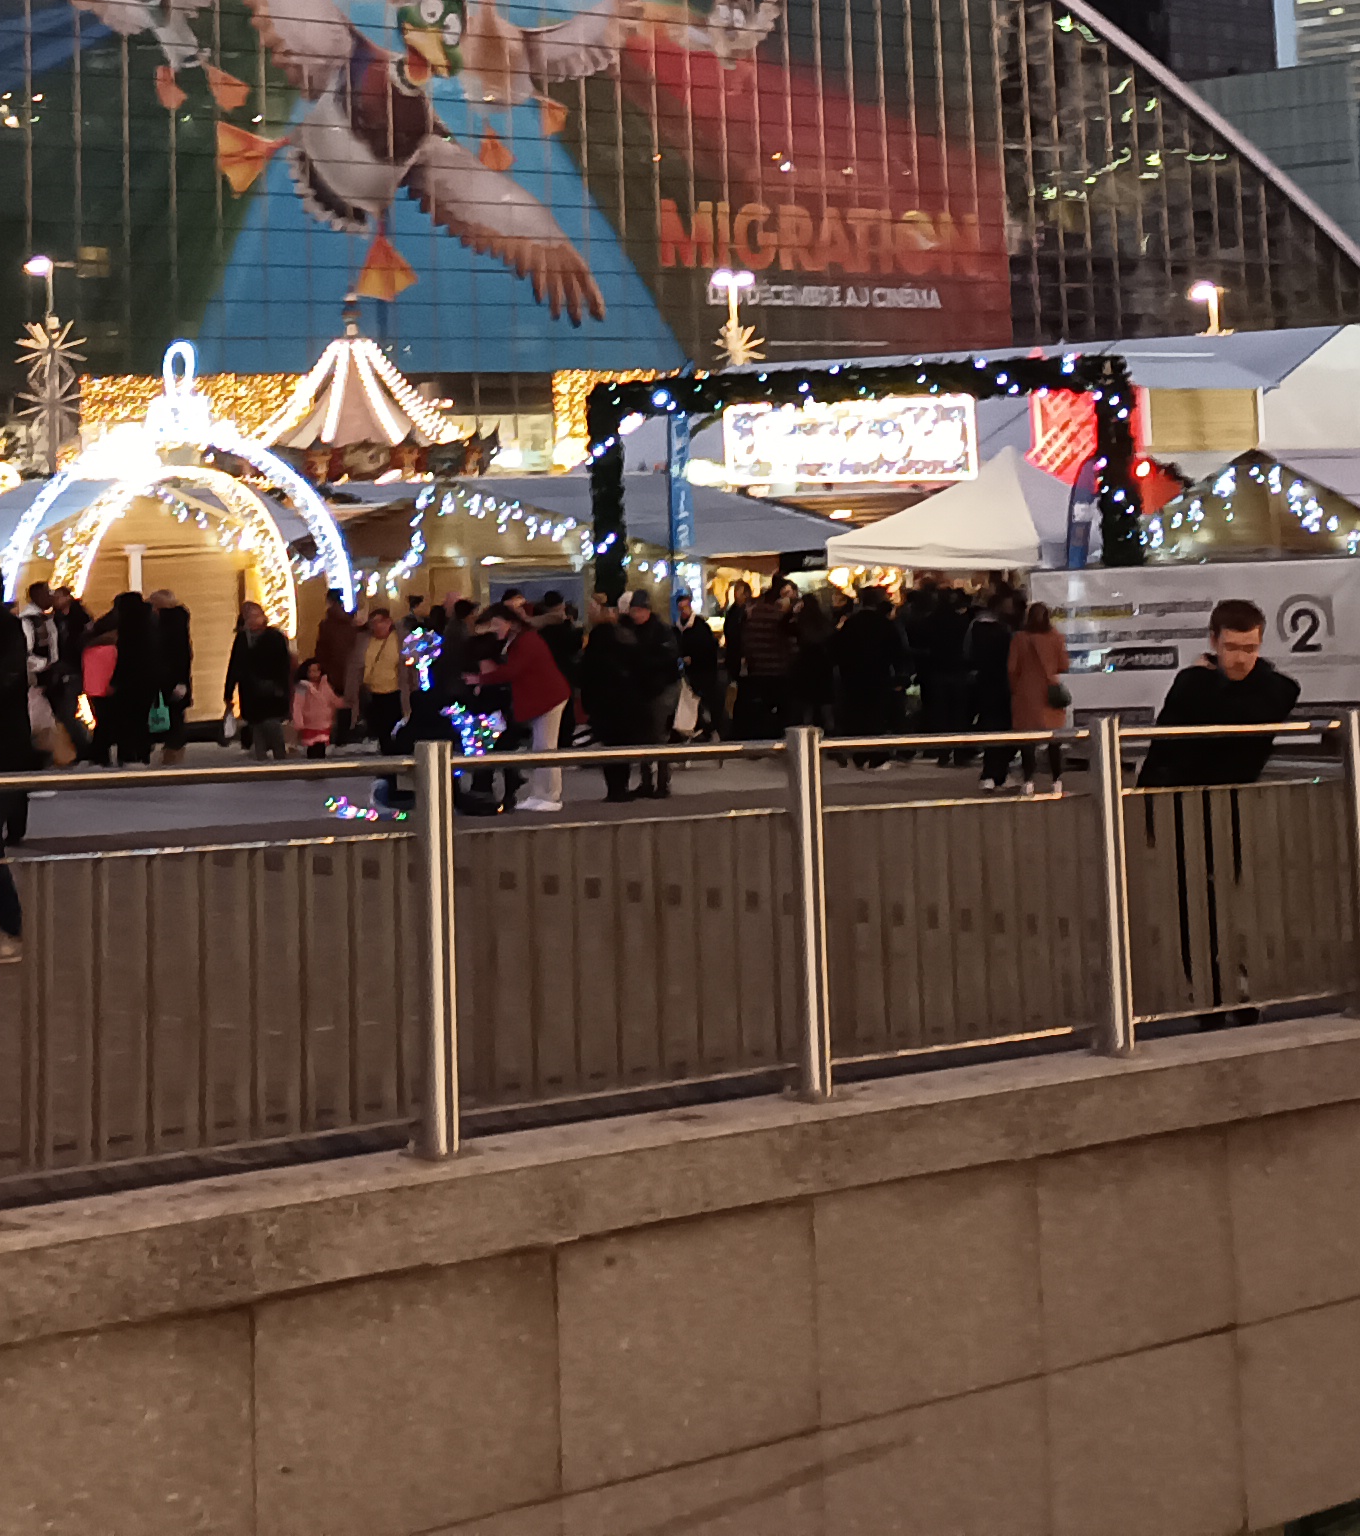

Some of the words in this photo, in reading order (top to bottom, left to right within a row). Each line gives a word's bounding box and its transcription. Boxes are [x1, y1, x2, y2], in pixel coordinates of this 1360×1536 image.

[660, 198, 982, 276] MIGRATION
[872, 282, 942, 309] CINÉMA
[1290, 607, 1323, 653] 2
